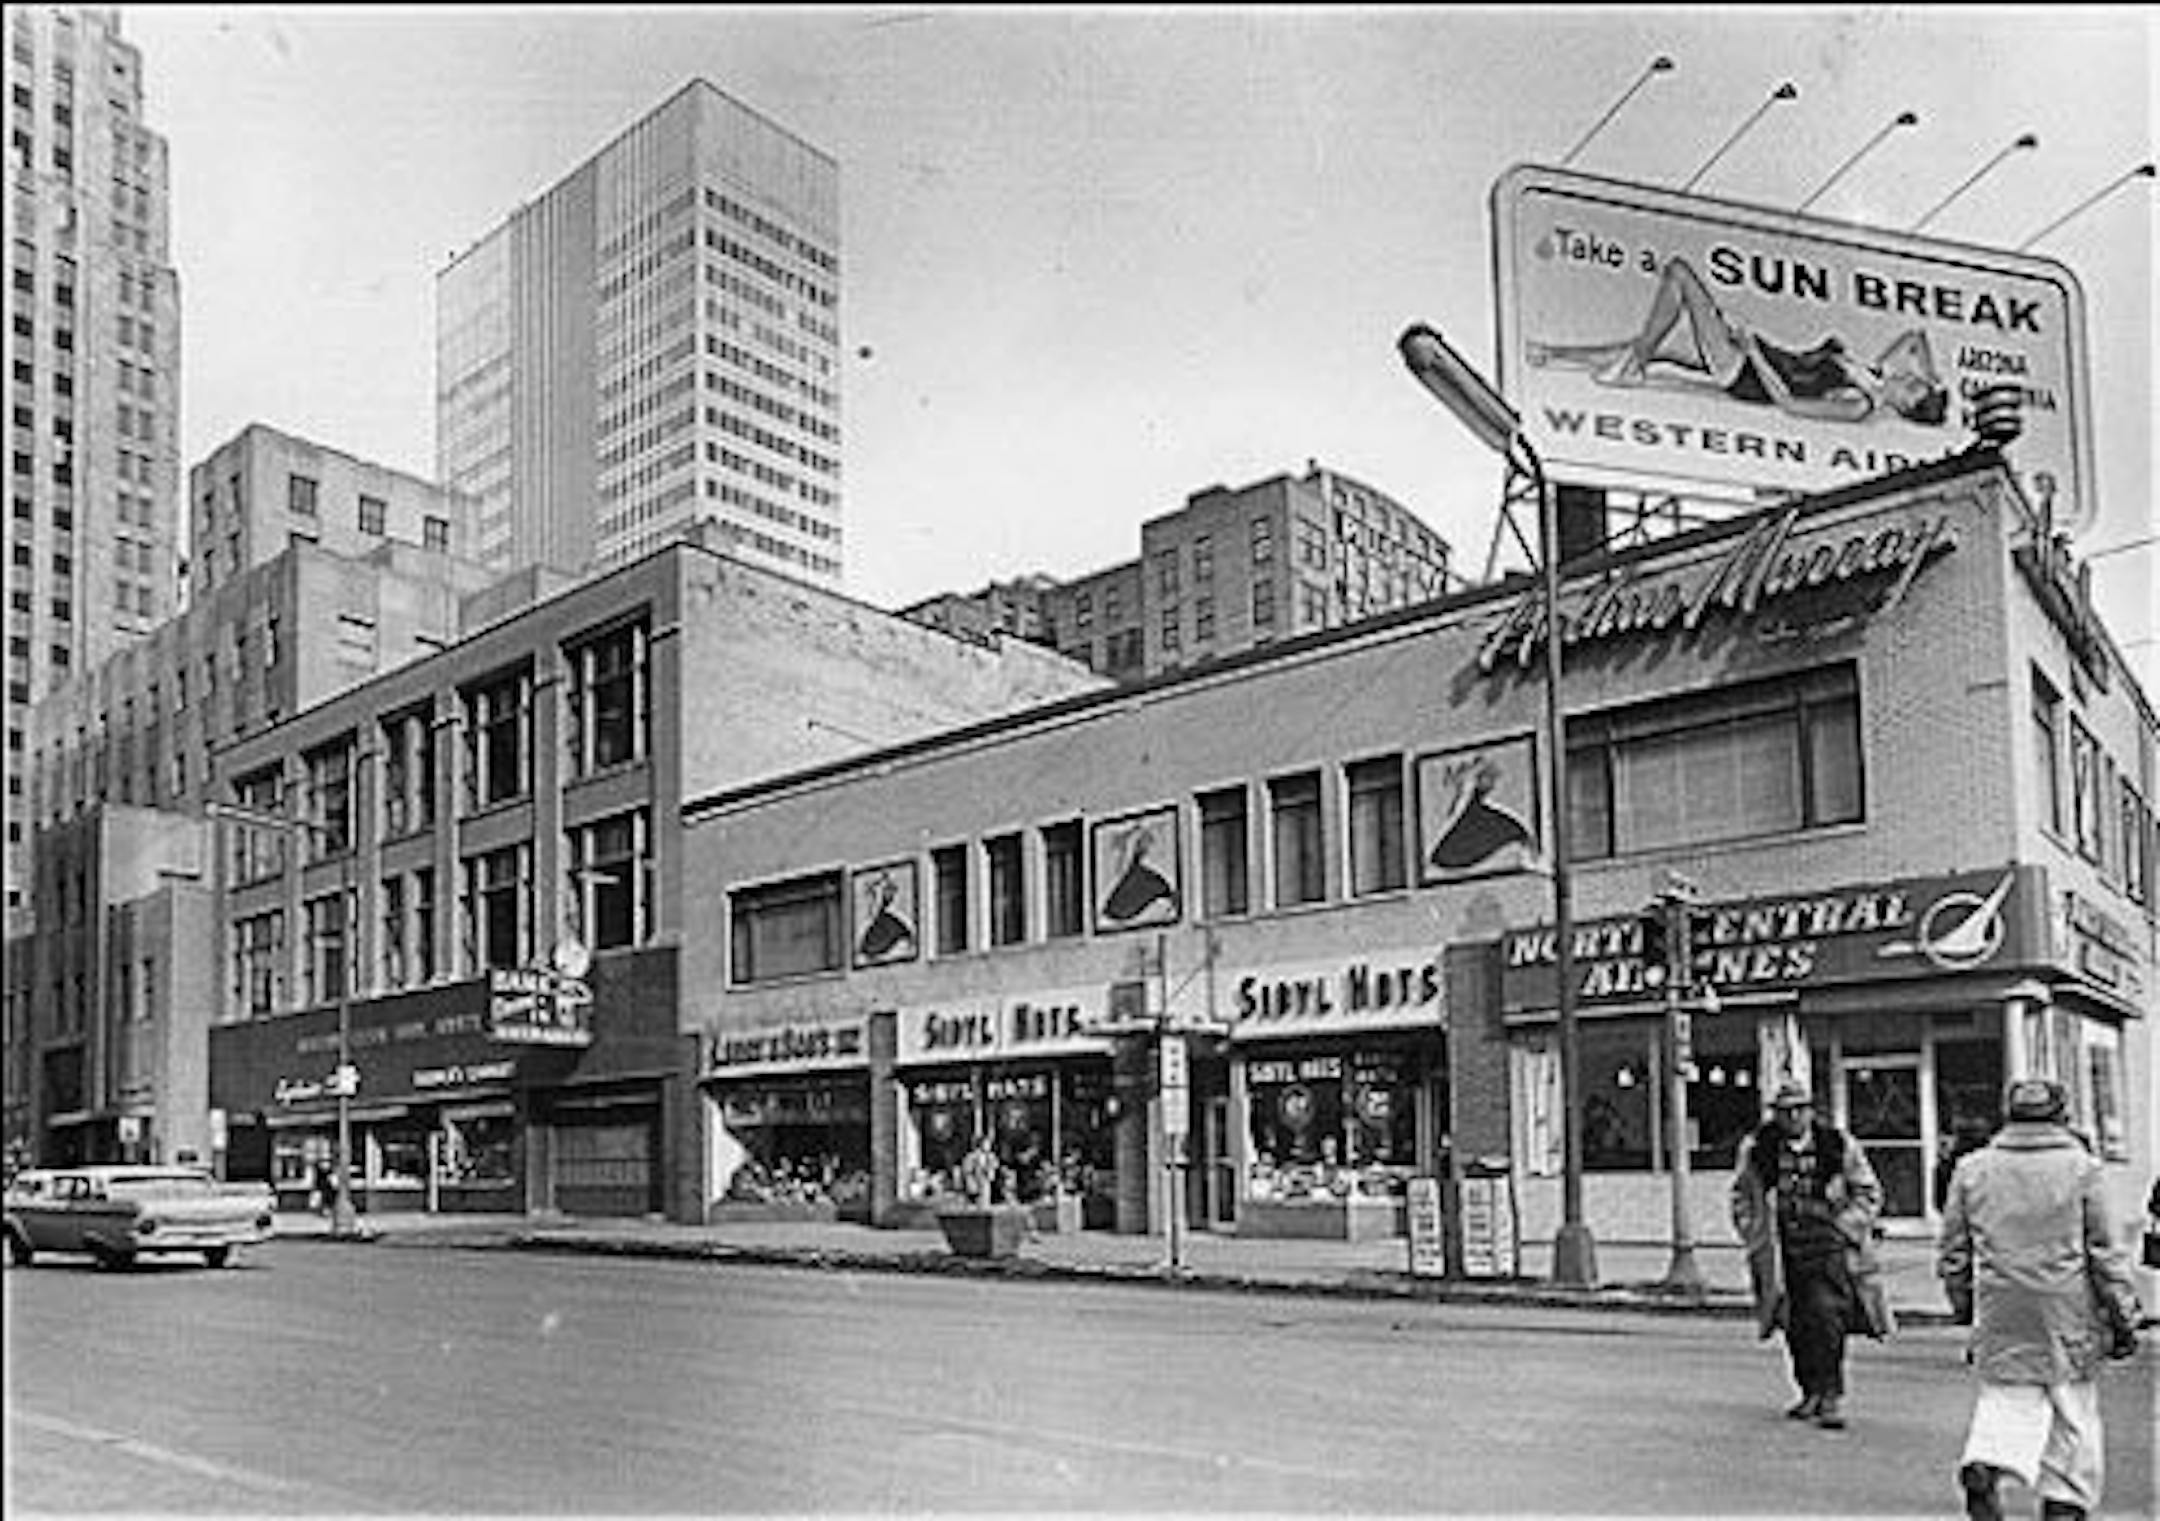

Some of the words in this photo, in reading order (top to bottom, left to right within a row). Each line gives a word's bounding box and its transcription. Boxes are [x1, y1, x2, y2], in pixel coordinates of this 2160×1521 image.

[1554, 227, 1624, 268] Take
[1641, 250, 1656, 273] a
[1710, 246, 1830, 300] SUN
[1855, 273, 2042, 333] BREAK
[1544, 408, 1805, 464] WESTERN
[1682, 507, 1957, 628] Murray
[1700, 893, 1915, 945] ENTRAL
